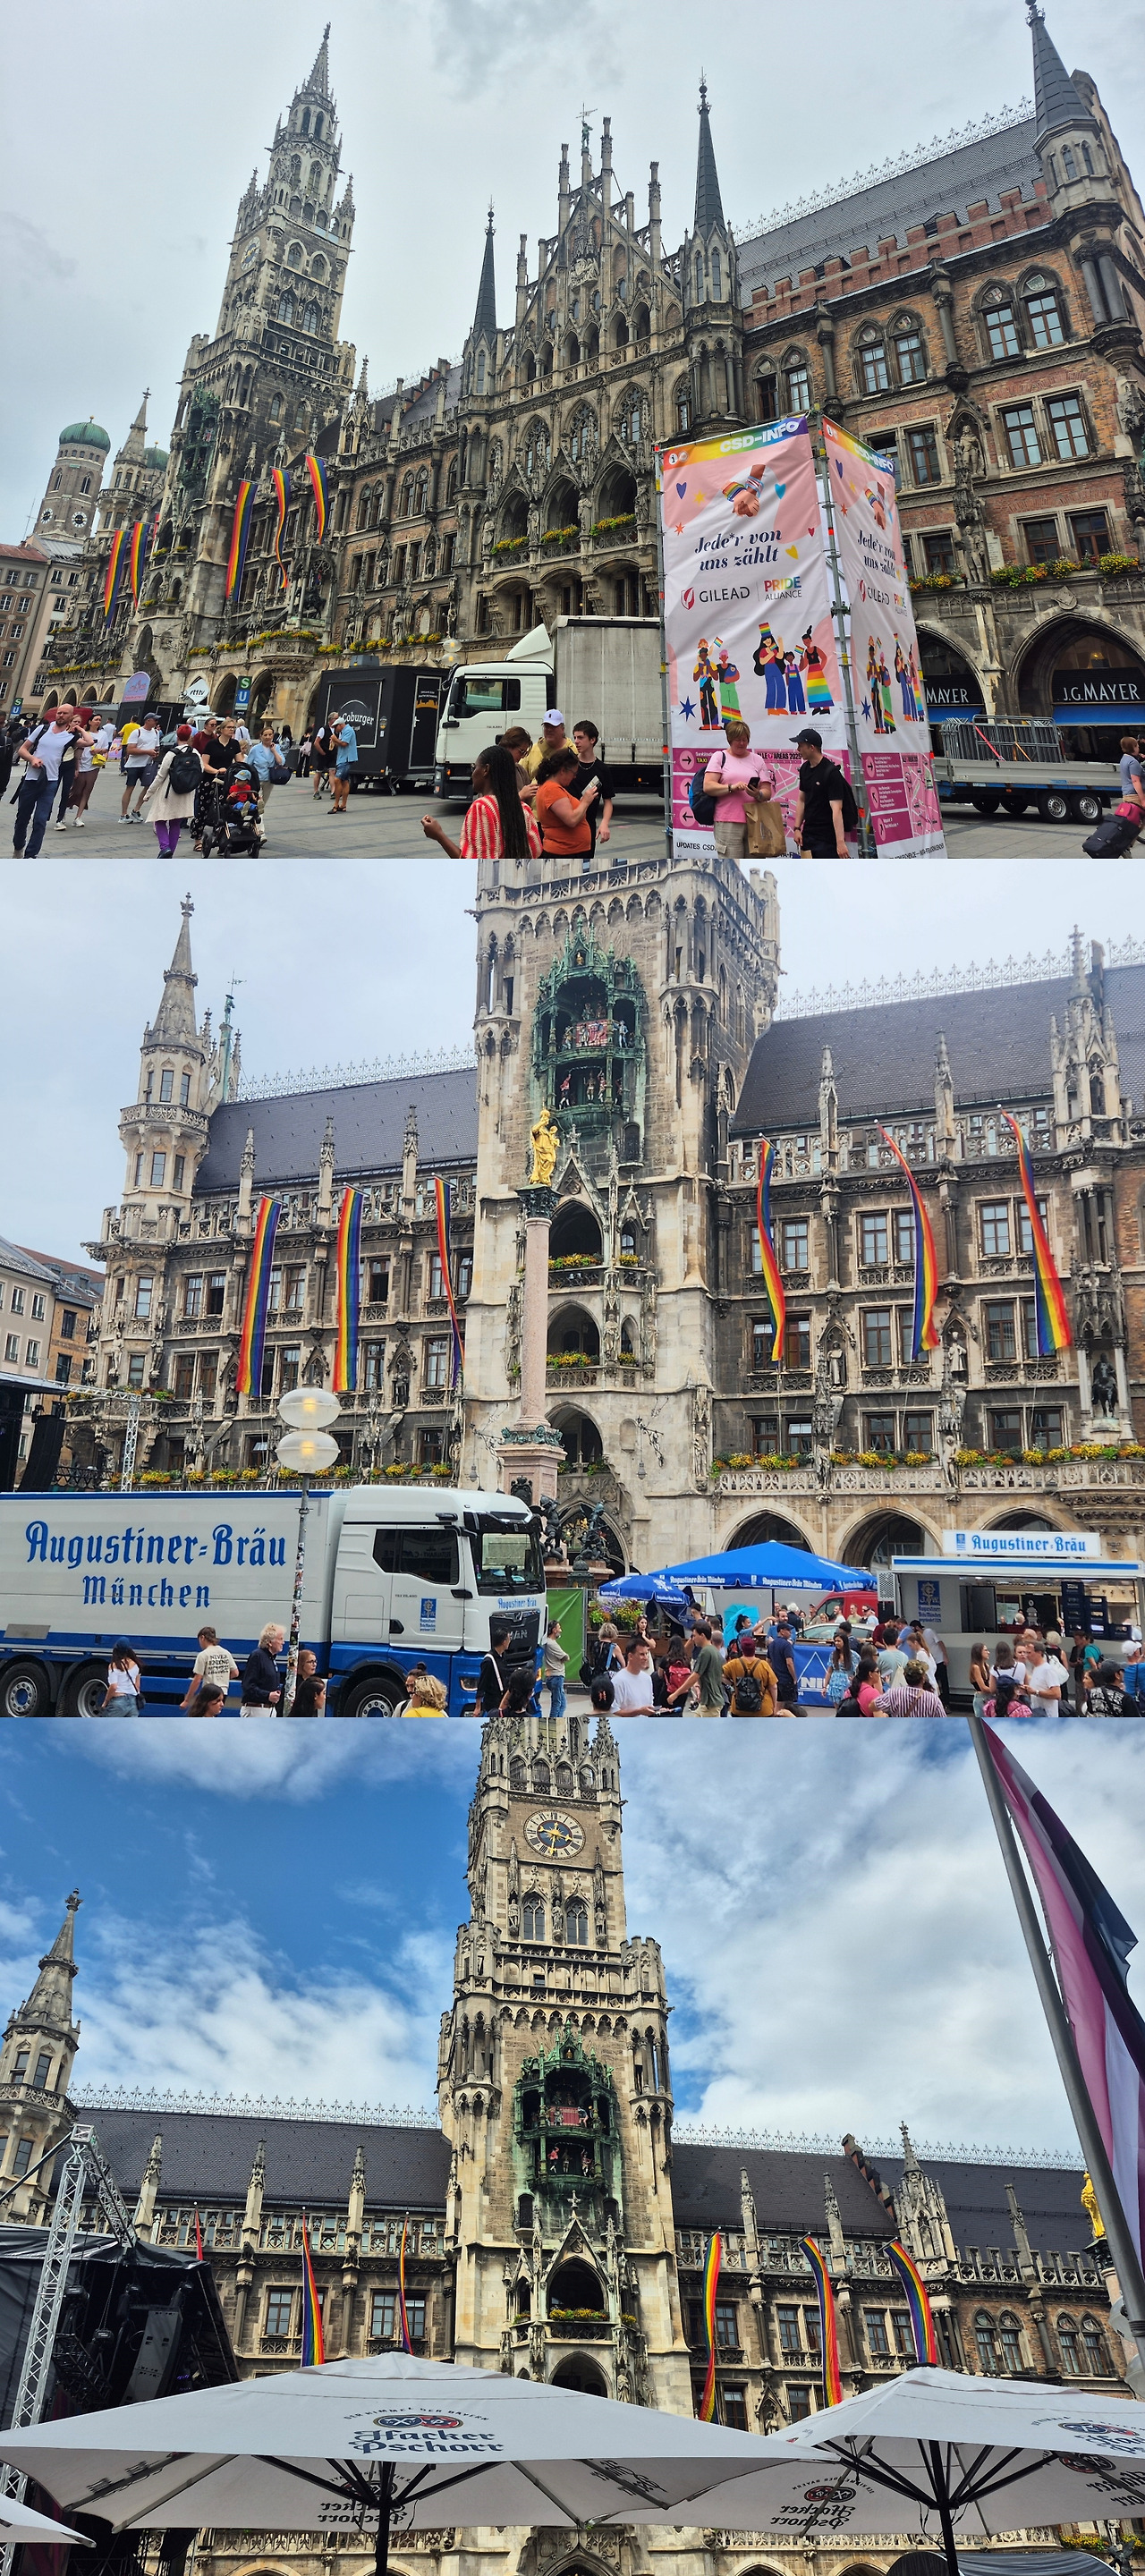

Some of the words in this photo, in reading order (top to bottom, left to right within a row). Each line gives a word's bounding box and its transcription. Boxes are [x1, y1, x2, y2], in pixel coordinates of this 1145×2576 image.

[720, 420, 800, 453] CSD-INFO
[749, 530, 782, 545] von
[700, 556, 728, 571] uns
[734, 545, 778, 566] zählt
[764, 576, 802, 592] PRIDE
[699, 586, 751, 603] GILEAD
[765, 589, 802, 601] ALLIANCE
[241, 677, 250, 689] S
[15, 698, 21, 706] S
[238, 691, 248, 702] U
[926, 687, 969, 704] MAYER
[342, 711, 375, 726] Coburger
[676, 842, 700, 850] UPDATES
[82, 1575, 211, 1608] München
[354, 2429, 495, 2442] Hacker
[348, 2440, 505, 2454] Pschorr
